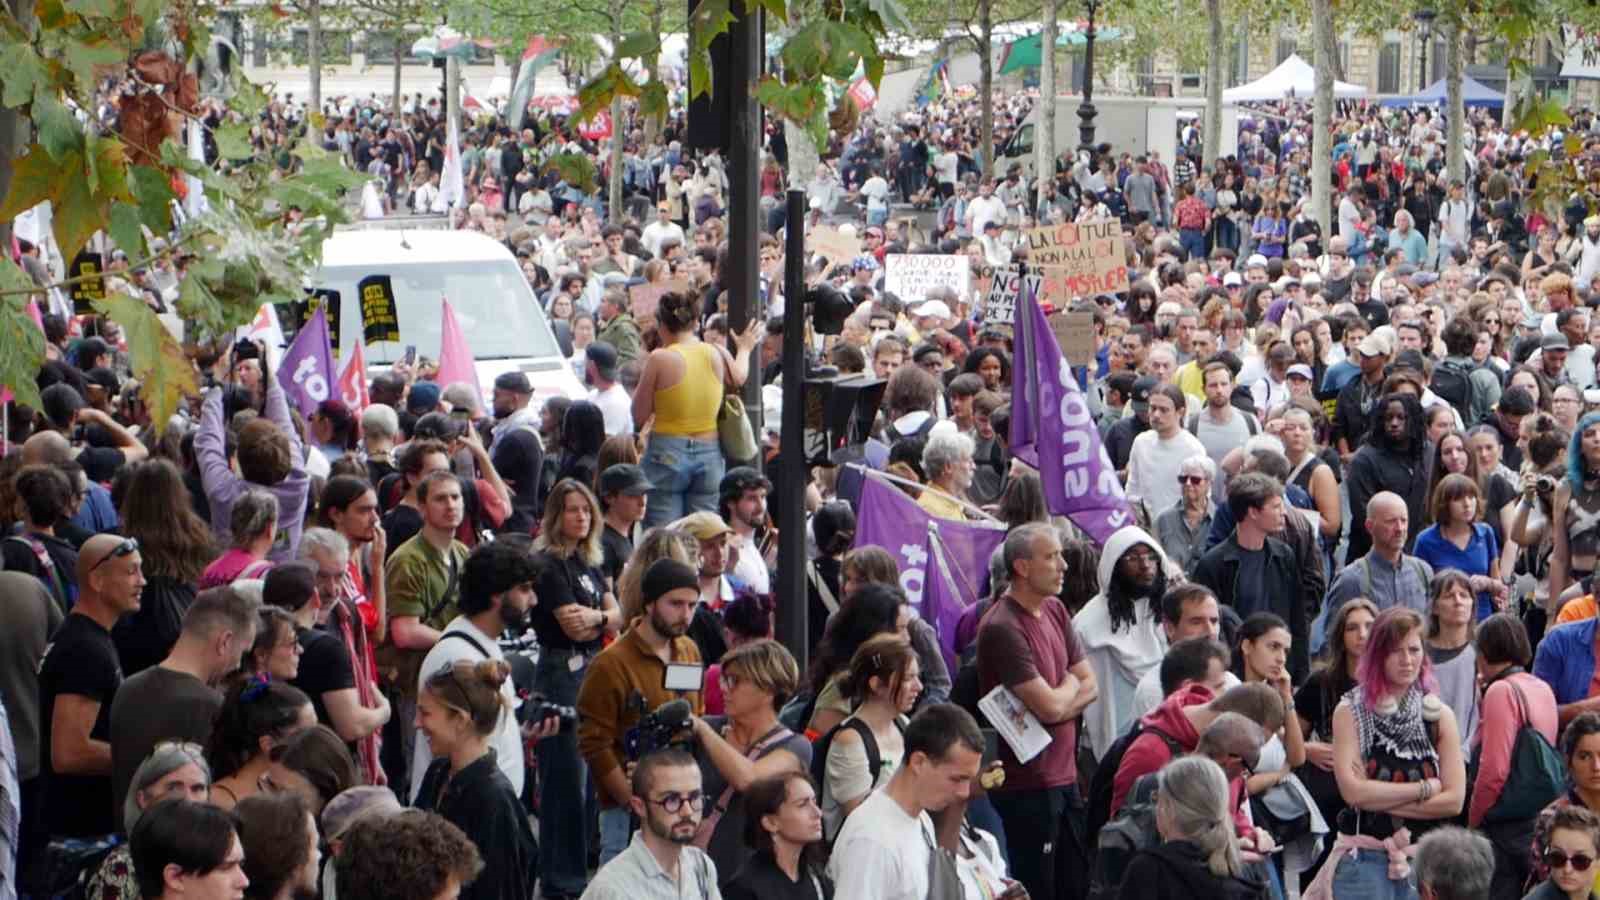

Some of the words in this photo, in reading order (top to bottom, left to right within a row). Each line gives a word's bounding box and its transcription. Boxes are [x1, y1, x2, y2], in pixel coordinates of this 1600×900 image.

[1028, 231, 1049, 250] LA
[1052, 223, 1080, 246] LOI
[1083, 221, 1118, 241] TUE
